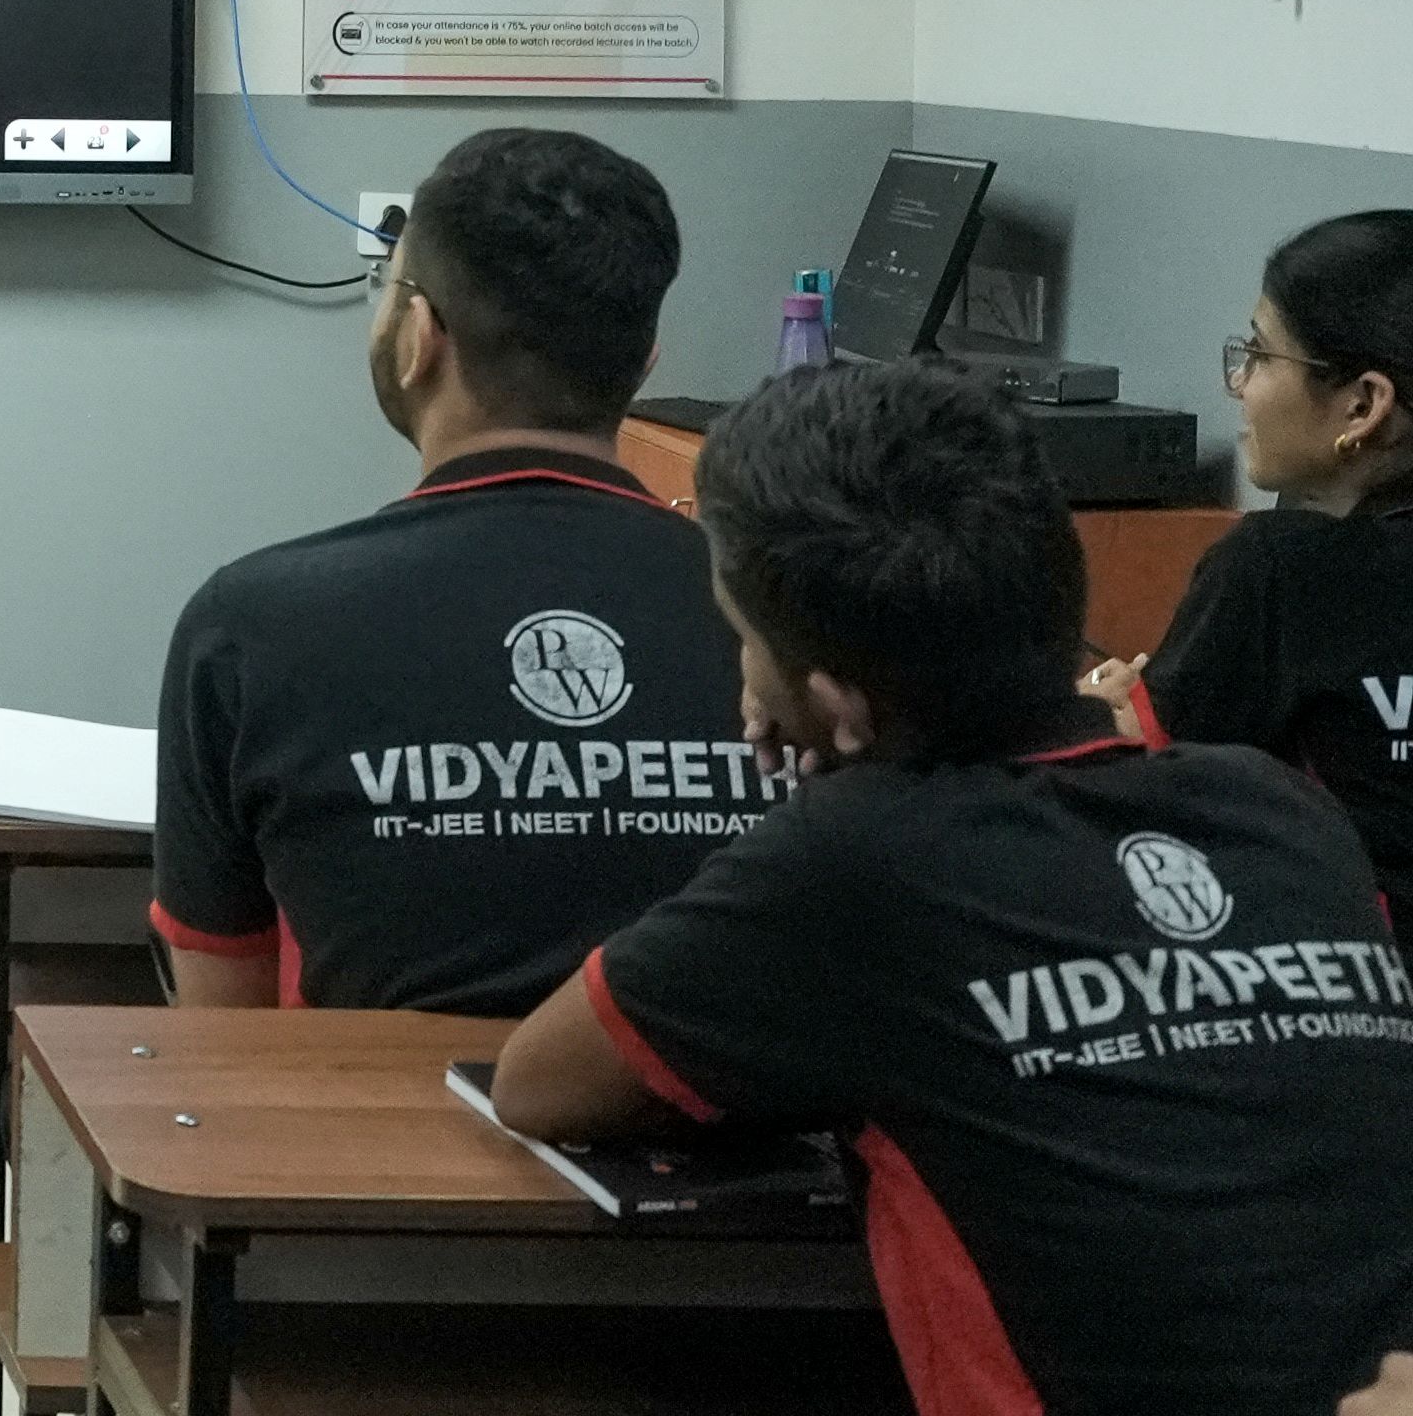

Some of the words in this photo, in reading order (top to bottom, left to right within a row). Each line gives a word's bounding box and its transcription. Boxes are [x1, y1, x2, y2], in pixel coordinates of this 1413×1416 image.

[350, 740, 798, 804] VIDYAPEETH
[373, 812, 485, 838] IIT-JEE
[511, 811, 593, 835] NEET
[619, 812, 765, 836] FOUNDAT
[967, 940, 1413, 1043] VIDYAPEETH
[1012, 1033, 1146, 1078] IIT-JEE
[1169, 1018, 1254, 1051] NEET
